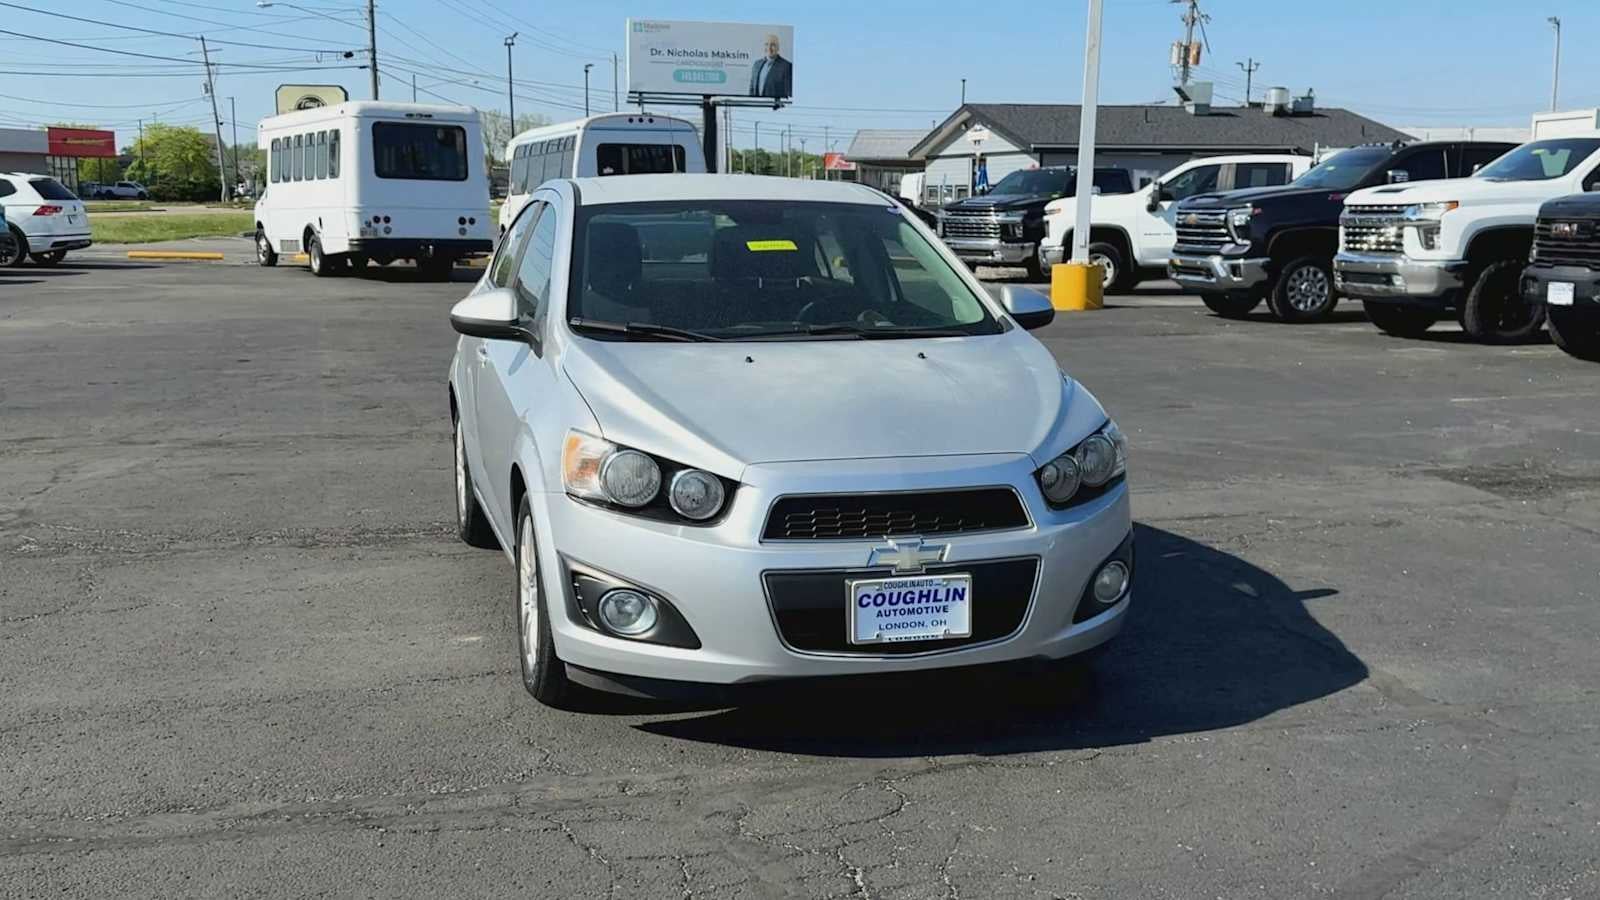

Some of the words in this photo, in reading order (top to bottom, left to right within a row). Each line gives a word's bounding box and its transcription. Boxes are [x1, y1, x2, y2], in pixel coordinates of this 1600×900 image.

[650, 48, 665, 57] Dr.
[667, 48, 708, 58] Nicholas
[711, 49, 749, 60] Maksim
[858, 587, 966, 608] COUGHLIN
[876, 605, 949, 618] AUTOMOTIVE
[931, 619, 947, 628] OH
